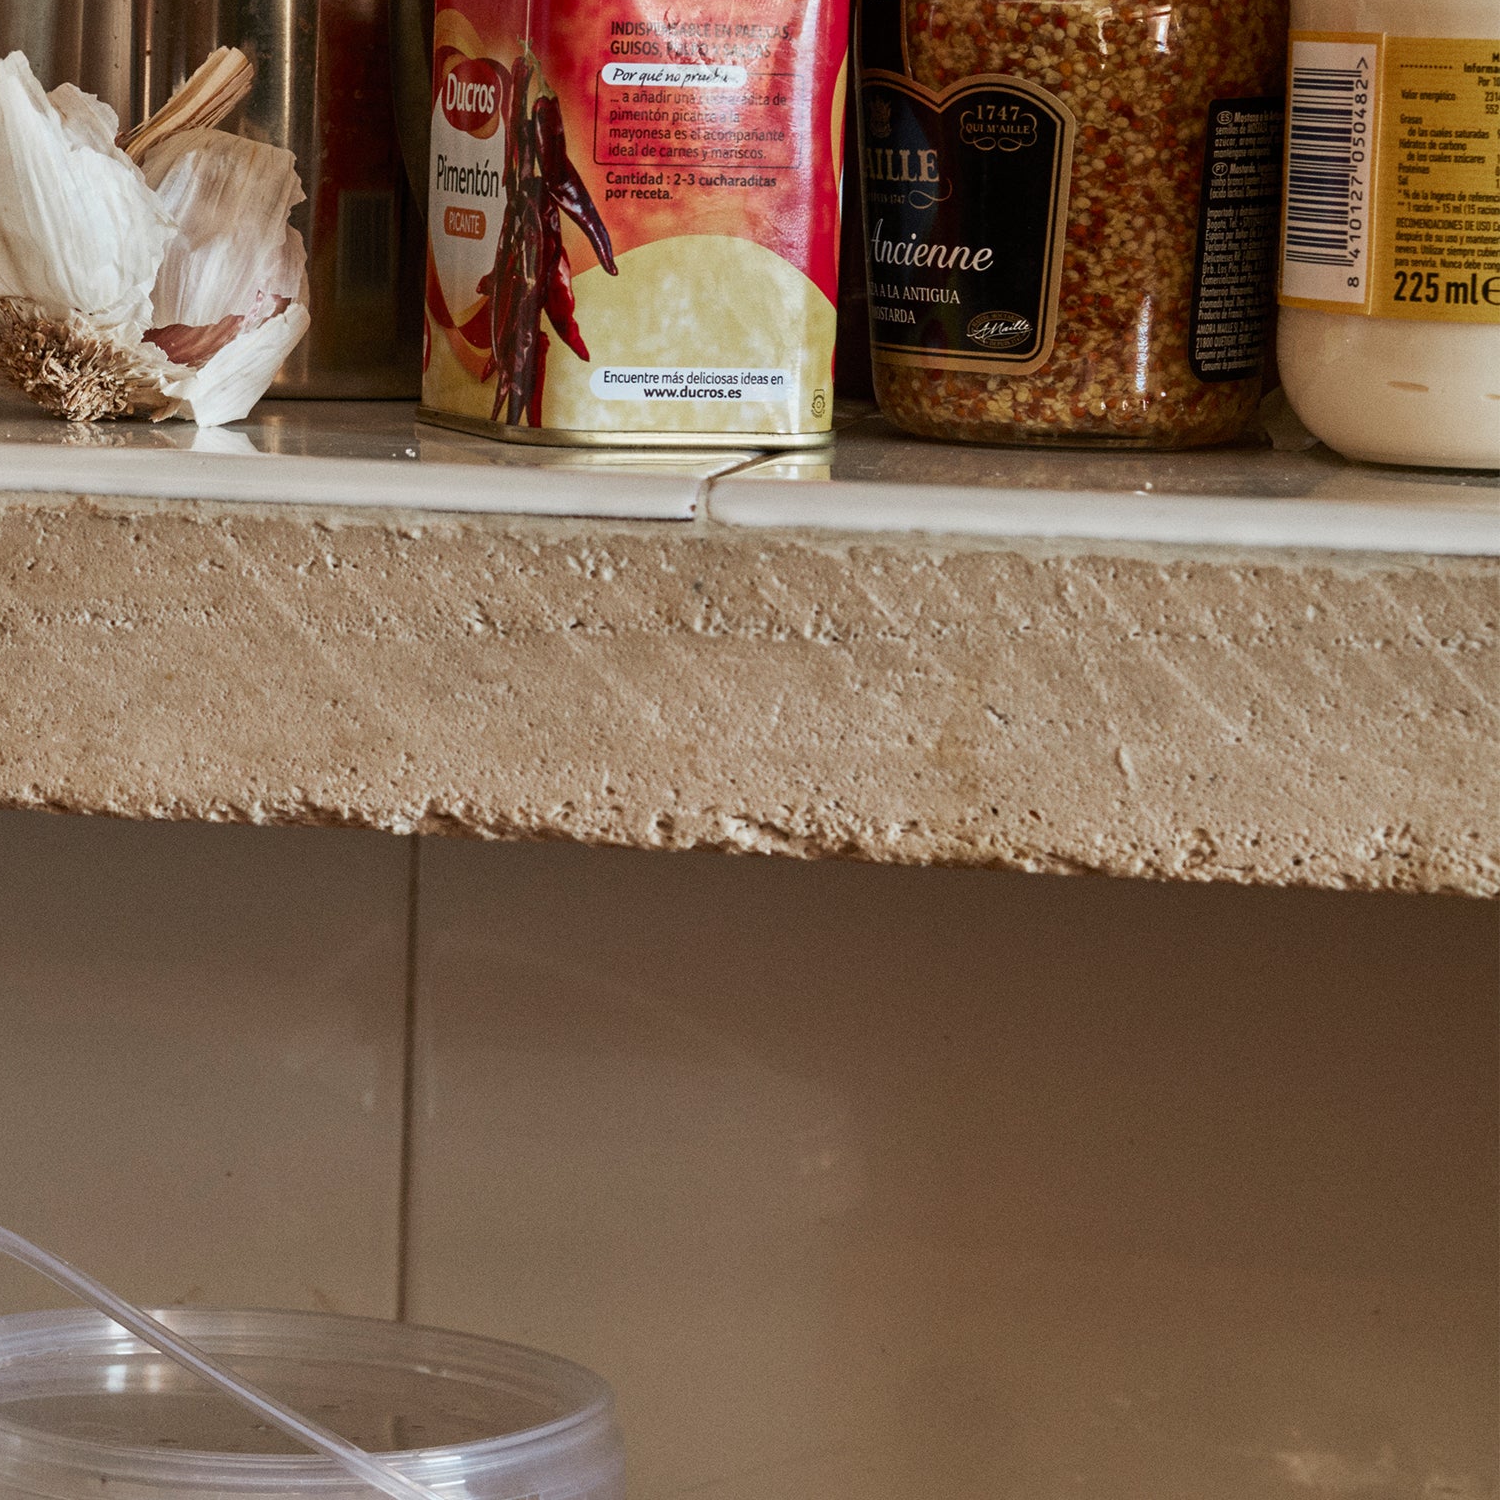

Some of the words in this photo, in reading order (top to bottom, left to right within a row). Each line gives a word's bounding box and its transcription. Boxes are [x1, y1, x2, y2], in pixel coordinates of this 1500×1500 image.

[610, 40, 662, 57] GUISOS,
[1464, 63, 1500, 73] Informa
[612, 68, 637, 81] Por
[639, 69, 663, 87] qué
[665, 71, 680, 82] no
[446, 73, 495, 114] Ducros
[622, 92, 629, 103] a
[633, 91, 671, 104] añadir
[674, 93, 695, 104] una
[772, 92, 787, 106] de
[609, 108, 669, 123] pimentón
[671, 110, 717, 125] picante
[976, 104, 1020, 121] 1747
[1220, 113, 1230, 122] ES
[1485, 104, 1499, 115] 552
[966, 123, 984, 134] QUI
[1352, 79, 1369, 163] 050482
[609, 127, 671, 142] mayonesa
[673, 128, 688, 140] es
[703, 126, 785, 143] acompañante
[1407, 128, 1416, 137] de
[1455, 129, 1489, 139] saturadas
[608, 143, 638, 156] ideal
[641, 143, 656, 157] de
[659, 145, 699, 158] carnes
[701, 148, 710, 161] y
[711, 146, 767, 160] mariscos.
[1428, 140, 1436, 149] de
[1407, 152, 1415, 161] de
[866, 148, 940, 183] AILLE
[436, 154, 499, 198] Pimentón
[606, 171, 663, 185] Cantidad
[673, 174, 695, 186] 2-3
[699, 173, 777, 187] cucharaditas
[605, 189, 628, 201] por
[630, 187, 674, 200] receta.
[1349, 176, 1364, 259] 410127
[1478, 205, 1500, 215] racion
[448, 211, 480, 235] PICANTE
[1396, 217, 1463, 230] RECOMENDACIONES
[1465, 221, 1474, 231] DE
[1476, 221, 1491, 232] USO
[1347, 276, 1360, 288] 8
[1394, 270, 1439, 303] 225
[1445, 273, 1478, 305] ml
[902, 286, 961, 305] ANTIGUA
[604, 370, 660, 384] Encuentre
[662, 370, 684, 385] más
[686, 371, 739, 385] deliciosas
[741, 372, 769, 385] ideas
[771, 374, 784, 385] en
[644, 386, 742, 399] www.ducros.es
